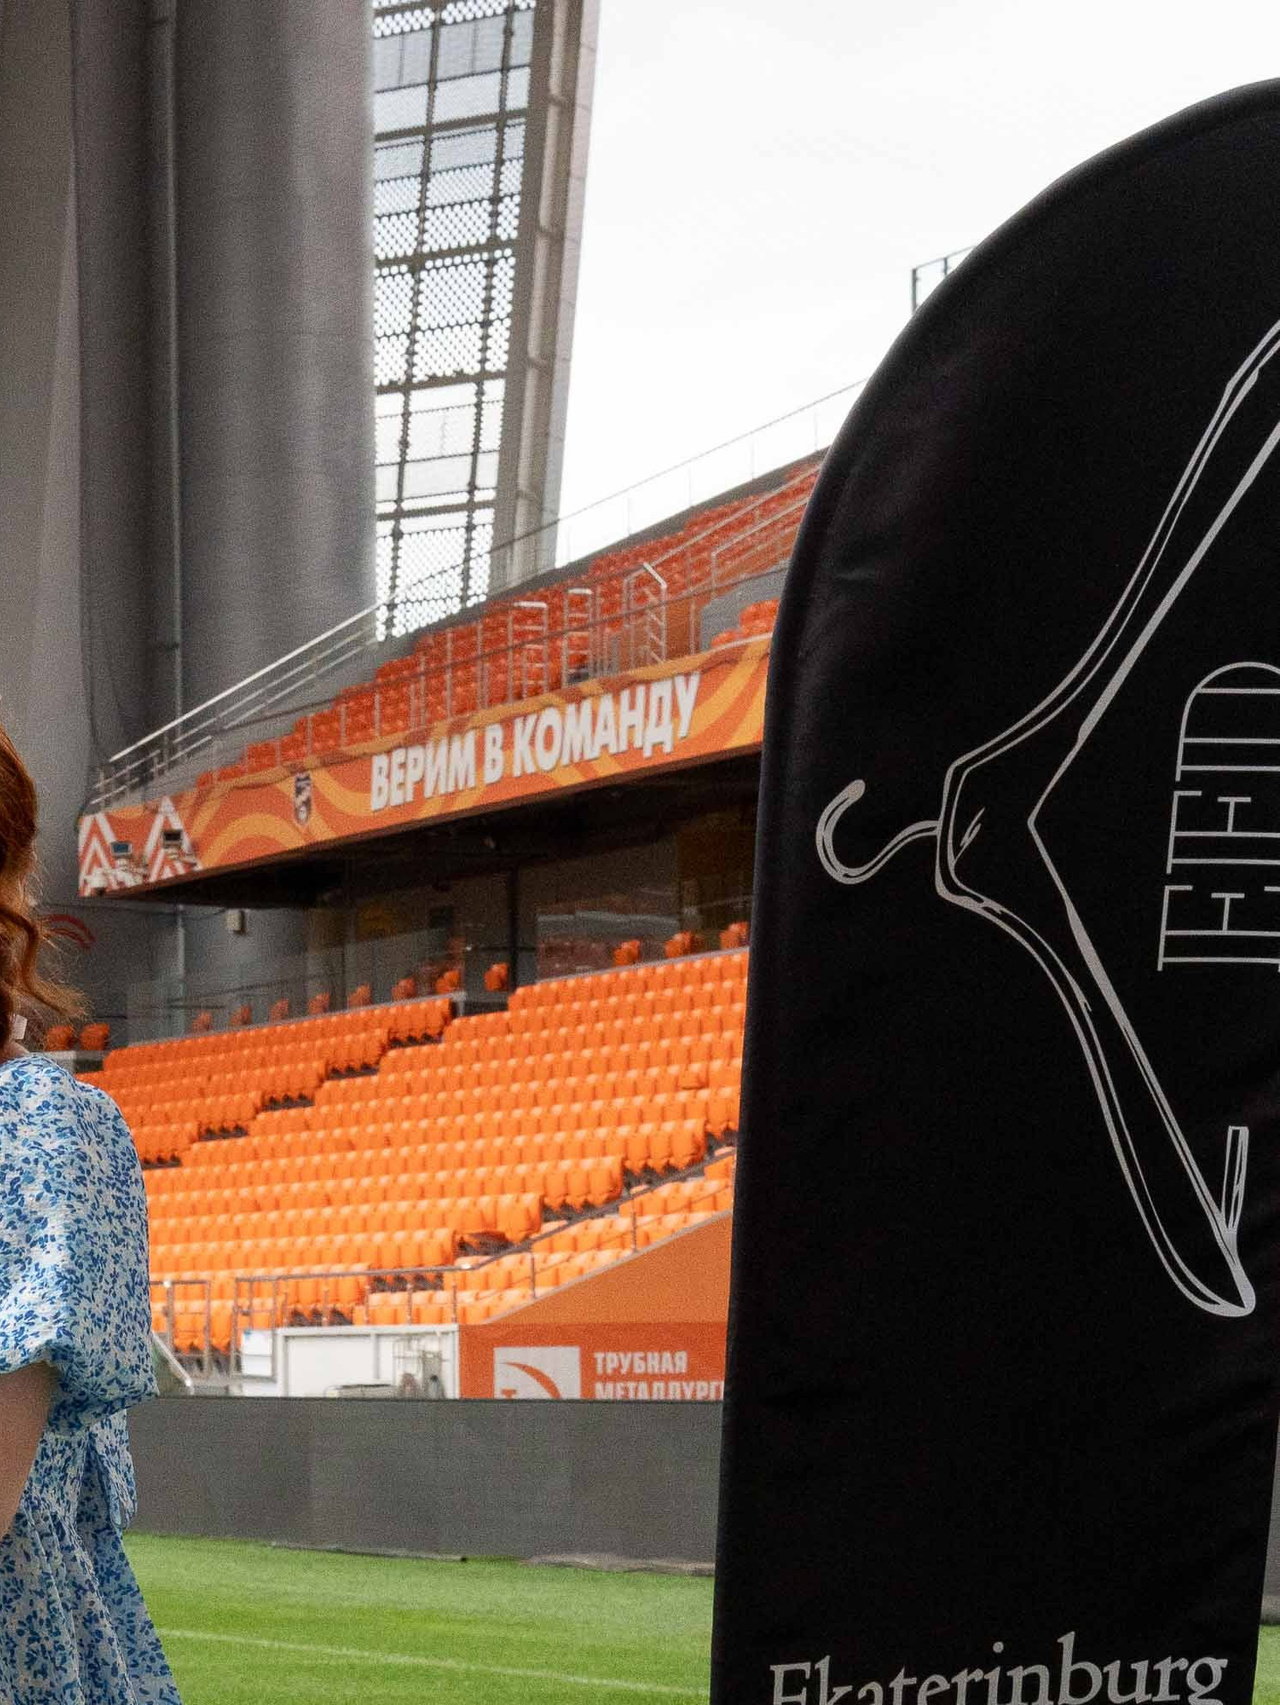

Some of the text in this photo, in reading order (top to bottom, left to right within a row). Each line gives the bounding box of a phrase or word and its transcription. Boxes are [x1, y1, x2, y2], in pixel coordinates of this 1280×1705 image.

[371, 671, 701, 812] ВЕРИМ В КОМАНДУ
[593, 1350, 689, 1375] ТРУБНАЯ
